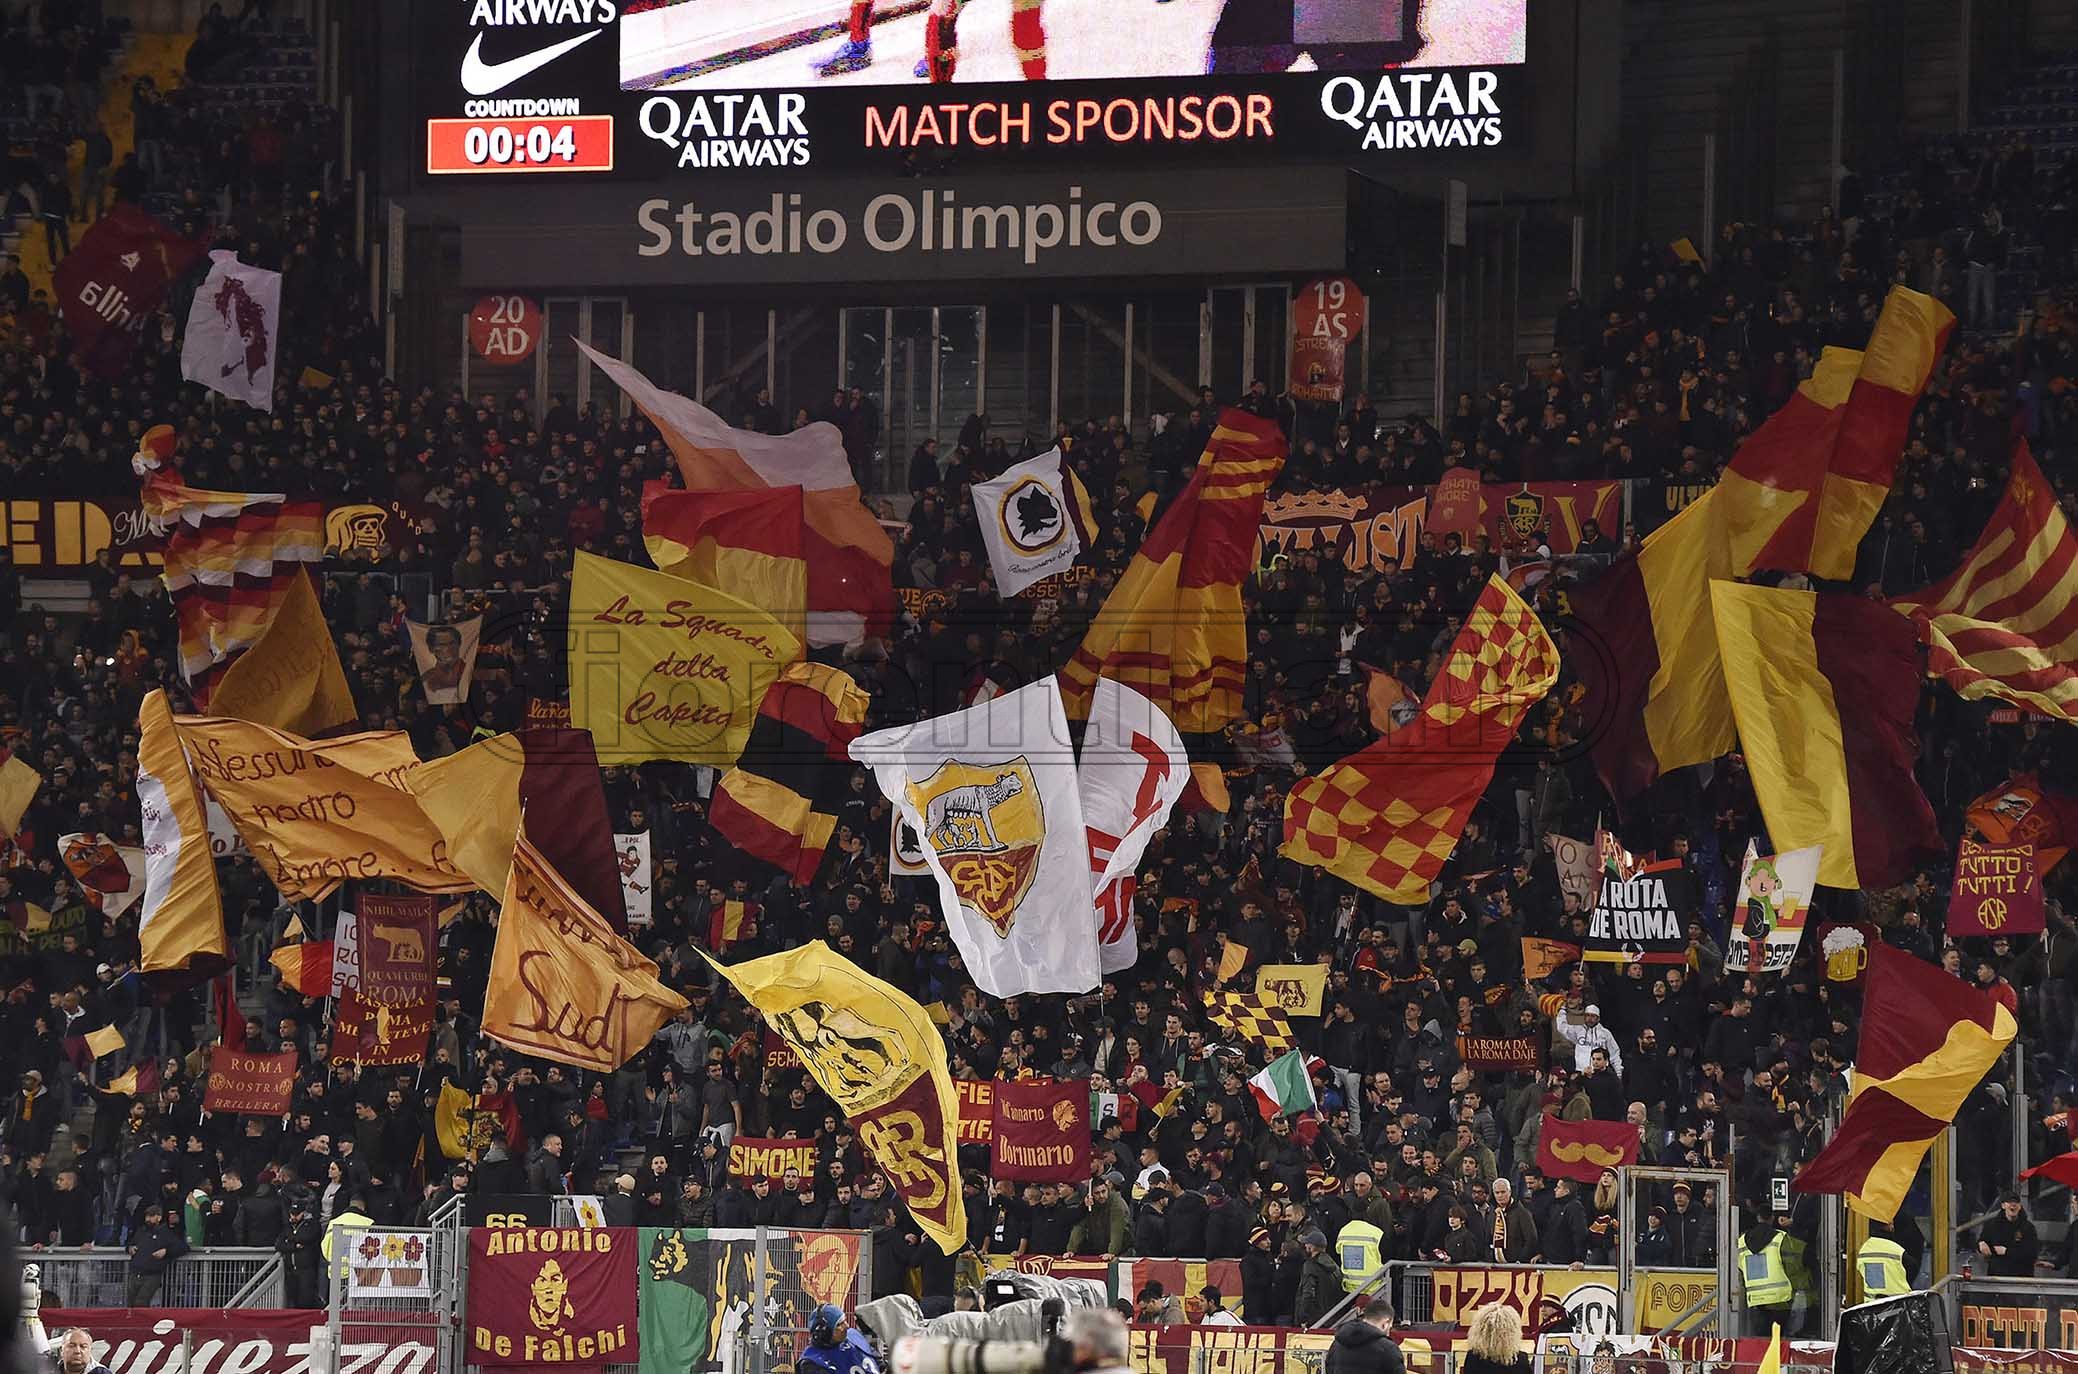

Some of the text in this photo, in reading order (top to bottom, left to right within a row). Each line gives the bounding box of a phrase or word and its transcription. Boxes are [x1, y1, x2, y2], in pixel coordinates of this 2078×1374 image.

[464, 98, 580, 118] COUNTDOWN
[1320, 71, 1501, 131] QATAR
[638, 93, 809, 149] QATAR
[863, 94, 1274, 148] MATCH SPONSOR
[1361, 117, 1502, 150] AIRWAYS
[463, 125, 575, 164] 00:04
[677, 137, 811, 168] AIRWAYS
[637, 186, 1163, 265] Stadio Olimpico
[489, 295, 526, 324] 20
[1313, 280, 1347, 311] 19
[1312, 311, 1349, 338] AS
[485, 327, 530, 356] AD
[593, 594, 776, 661] La Squadr
[654, 650, 731, 682] della
[624, 691, 733, 736] Capita
[1959, 855, 2022, 876] TUTTO
[1589, 908, 1682, 941] DE ROMA
[1977, 897, 2009, 931] ASR
[335, 946, 359, 967] RO
[332, 971, 359, 991] SO
[508, 950, 614, 1053] Sud
[372, 1044, 392, 1056] IN
[1480, 1038, 1511, 1050] ROMA
[1481, 1049, 1511, 1061] ROMA
[231, 1057, 283, 1074] ROMA
[226, 1079, 281, 1094] NOSTRA
[957, 1081, 993, 1105] FIE
[957, 1118, 993, 1141] TIF
[728, 1144, 816, 1178] SIMONE
[486, 1226, 612, 1257] Antonio
[1432, 1271, 1540, 1328] OZZY
[1651, 1281, 1717, 1314] FORZ
[475, 1324, 627, 1362] De Falchi
[1188, 1329, 1277, 1374] NOME
